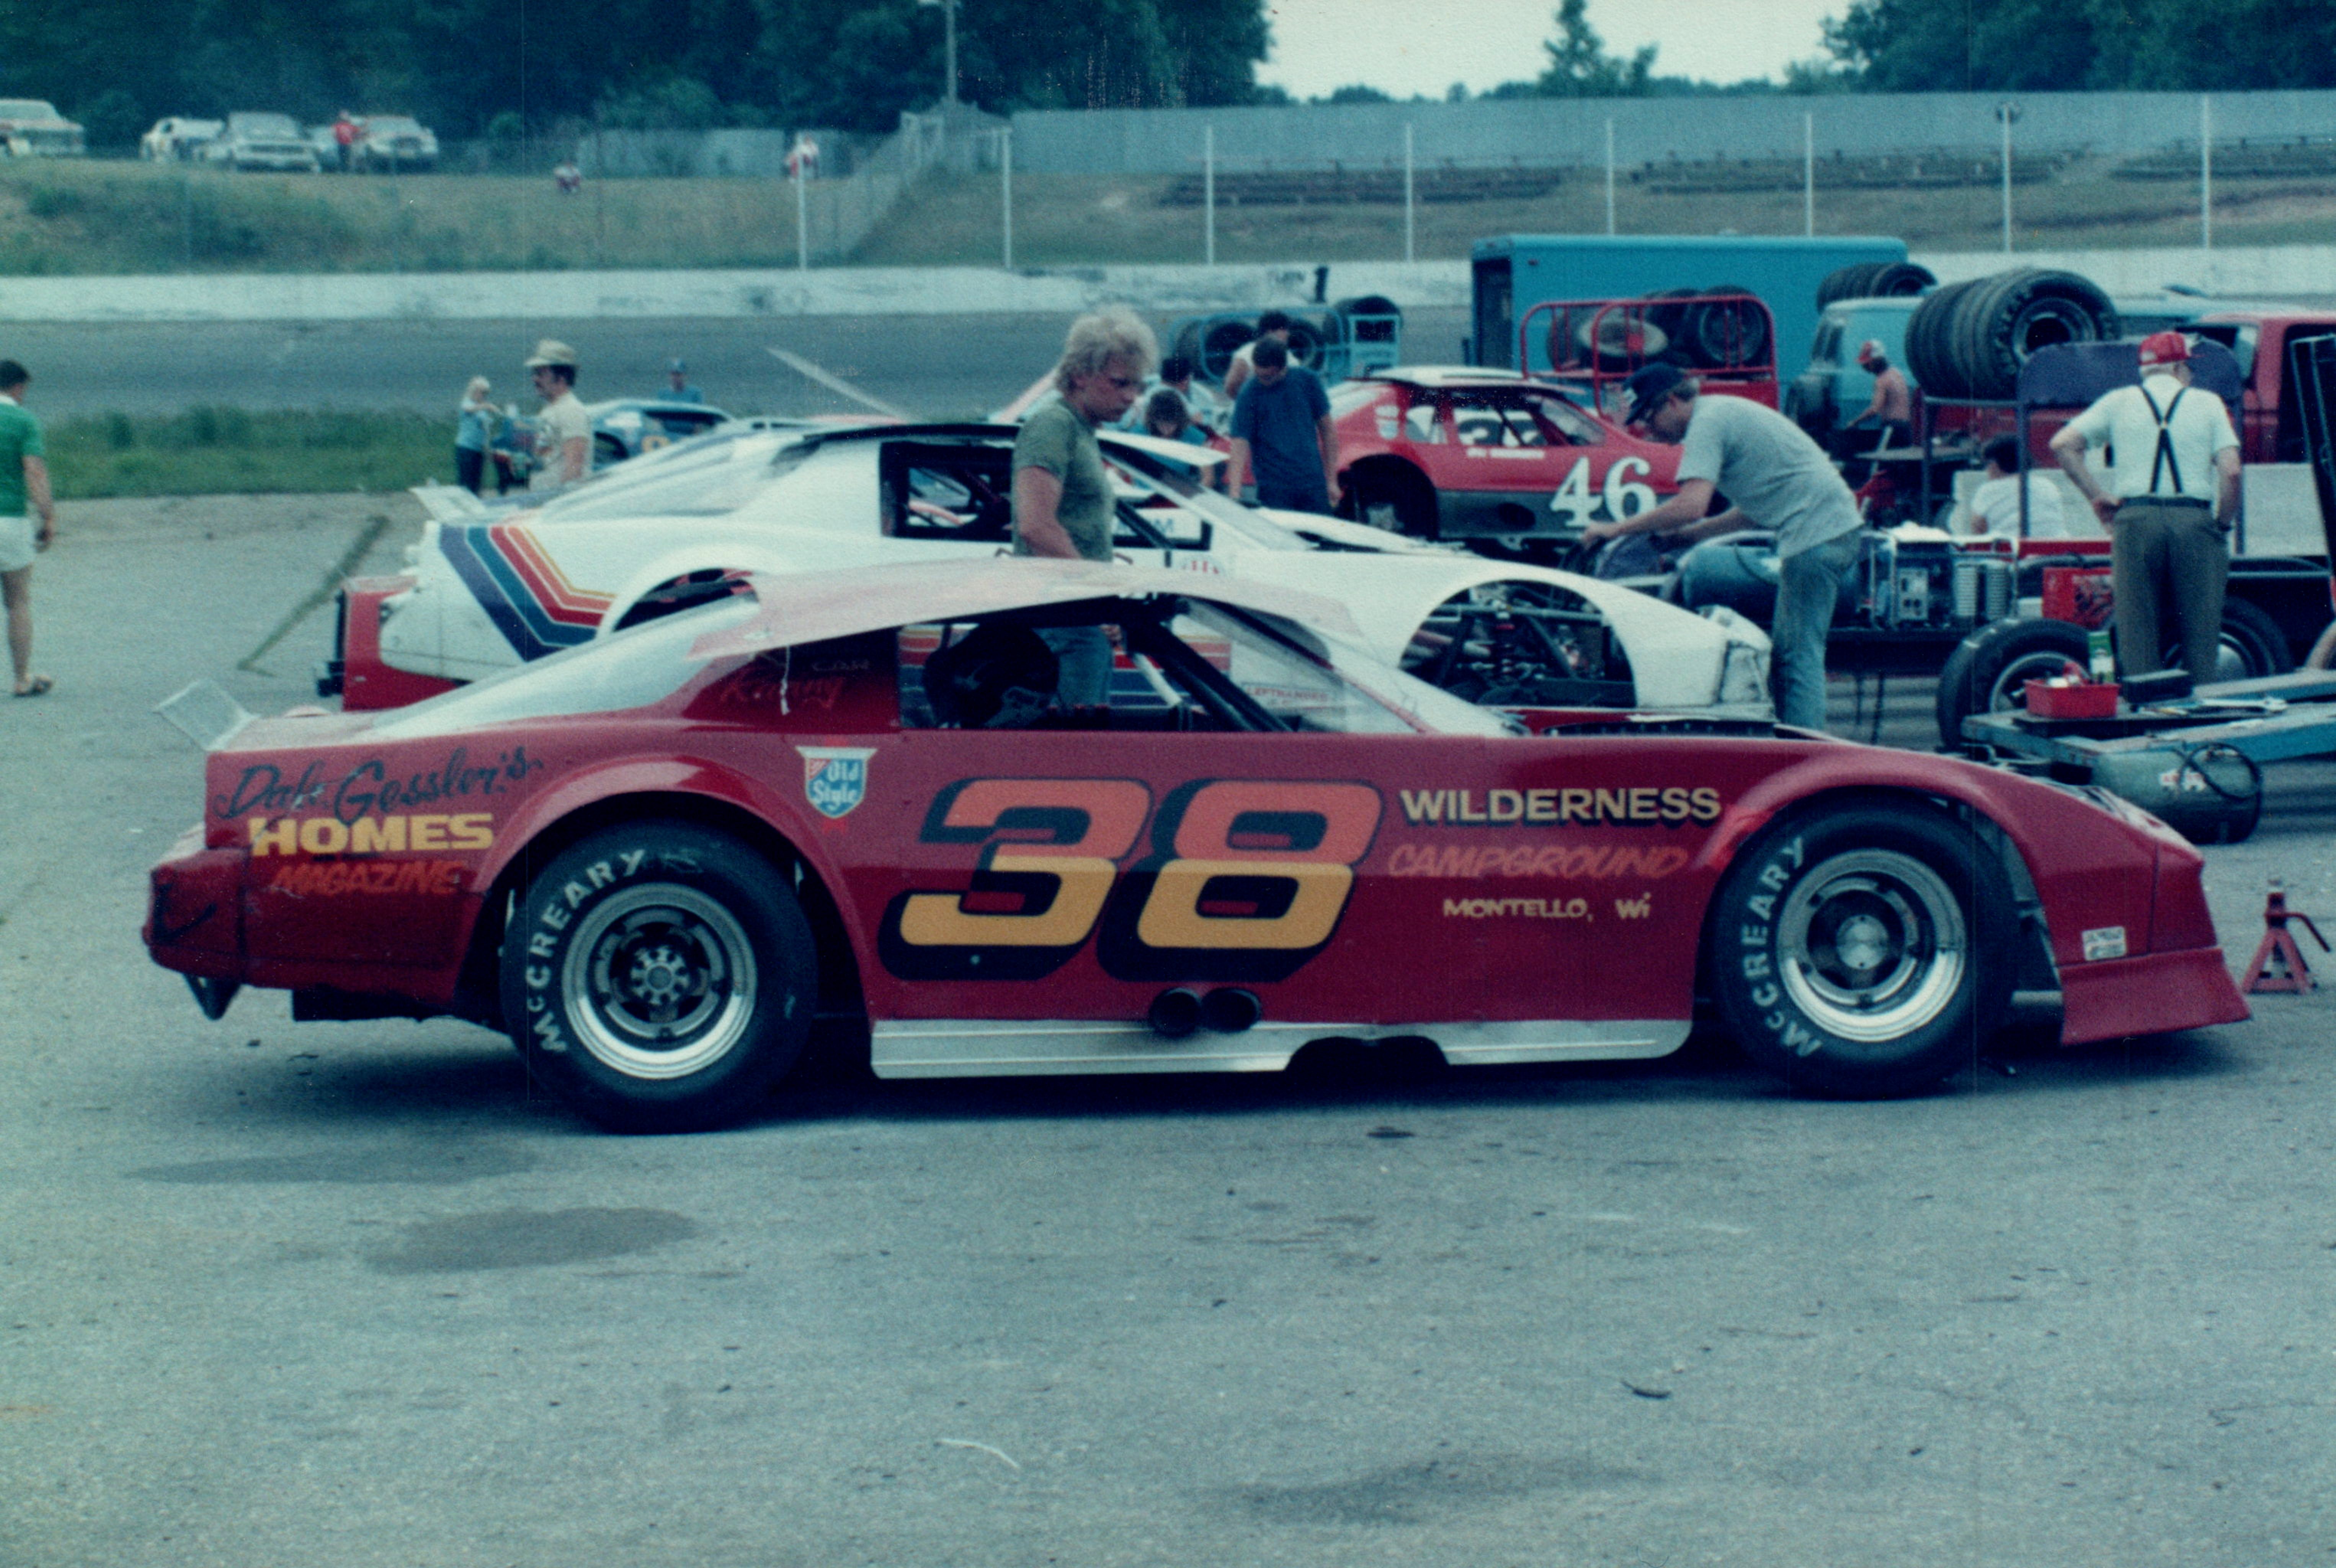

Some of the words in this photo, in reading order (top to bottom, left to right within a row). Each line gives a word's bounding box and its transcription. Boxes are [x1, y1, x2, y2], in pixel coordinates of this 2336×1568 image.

[1549, 456, 1658, 527] 46
[827, 761, 859, 782] Old
[813, 779, 858, 811] Style
[1400, 787, 1723, 825] WILDERNESS
[248, 813, 494, 856] HOMES
[270, 859, 465, 896] MAGAZINE
[879, 777, 1384, 983] 38
[1387, 844, 1687, 879] CAMPGROUND
